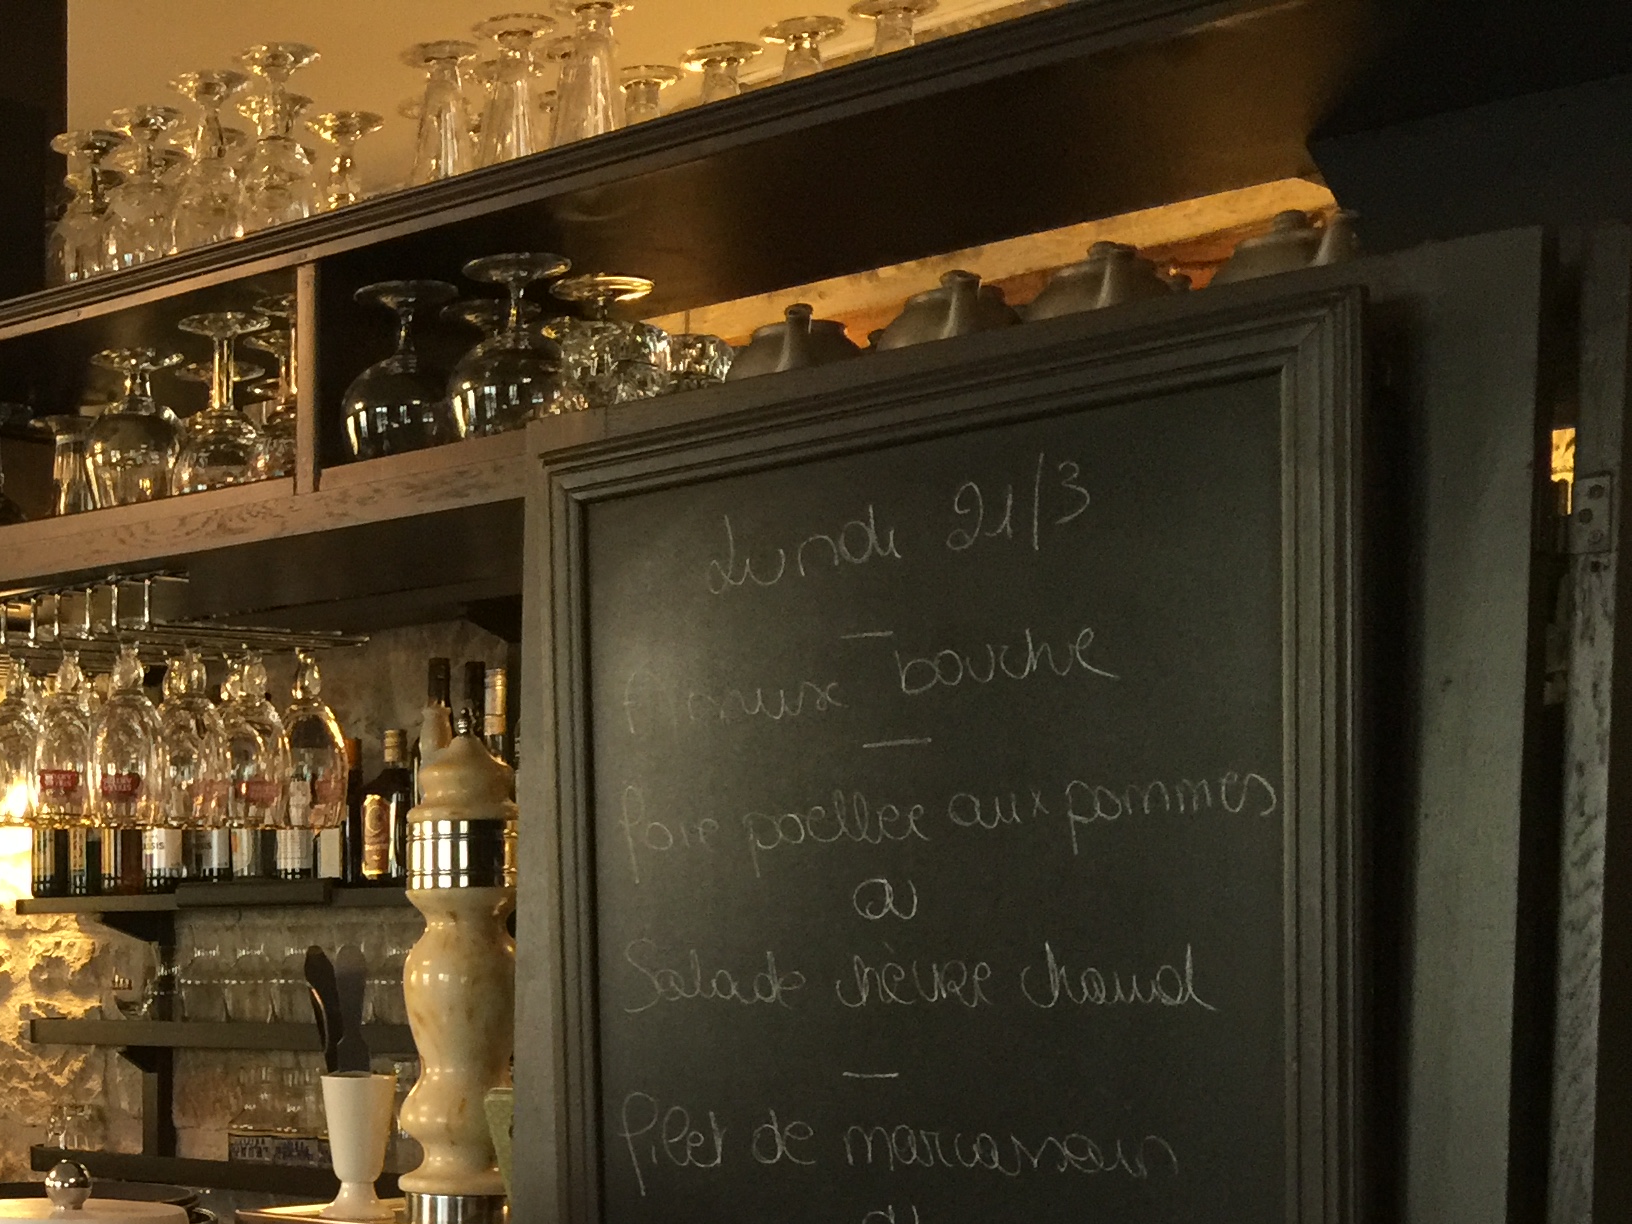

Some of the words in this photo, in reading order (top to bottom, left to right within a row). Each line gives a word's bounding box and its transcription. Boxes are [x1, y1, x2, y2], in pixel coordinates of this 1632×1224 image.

[708, 505, 902, 596] Lundi
[946, 453, 1091, 551] 21/3
[894, 627, 1120, 694] bouche
[948, 789, 1050, 829] aux
[1065, 771, 1277, 856] pommes
[624, 938, 808, 1013] Salade
[1022, 941, 1218, 1011] chaud
[753, 1109, 816, 1165] de
